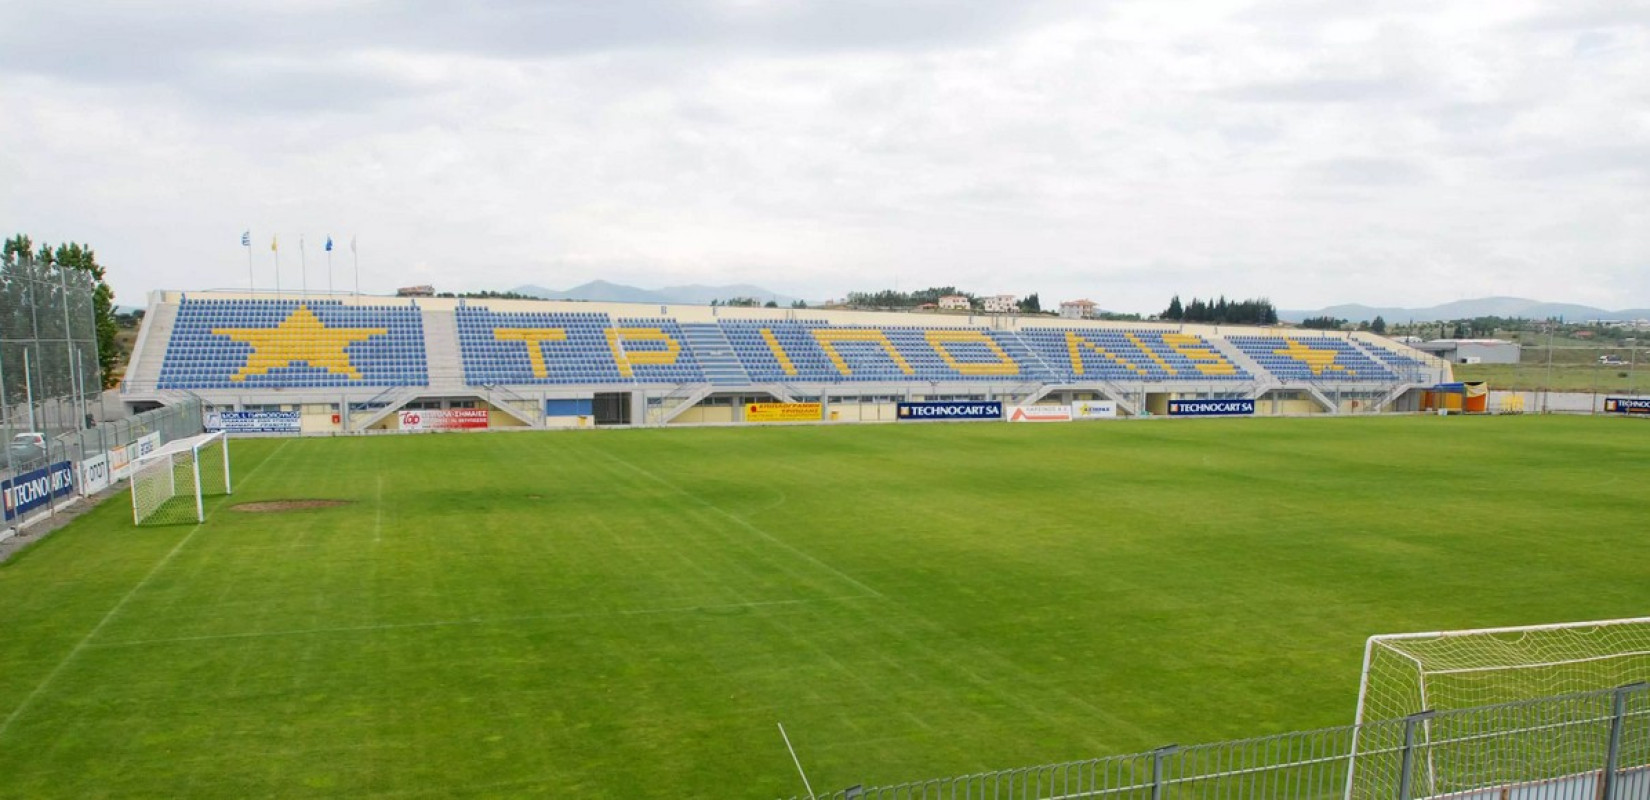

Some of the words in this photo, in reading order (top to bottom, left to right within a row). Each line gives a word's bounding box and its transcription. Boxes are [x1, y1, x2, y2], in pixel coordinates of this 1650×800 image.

[912, 406, 985, 416] TECHNOCART
[985, 406, 999, 415] SA
[1180, 403, 1240, 412] TECHNOCART
[1241, 402, 1253, 411] SA
